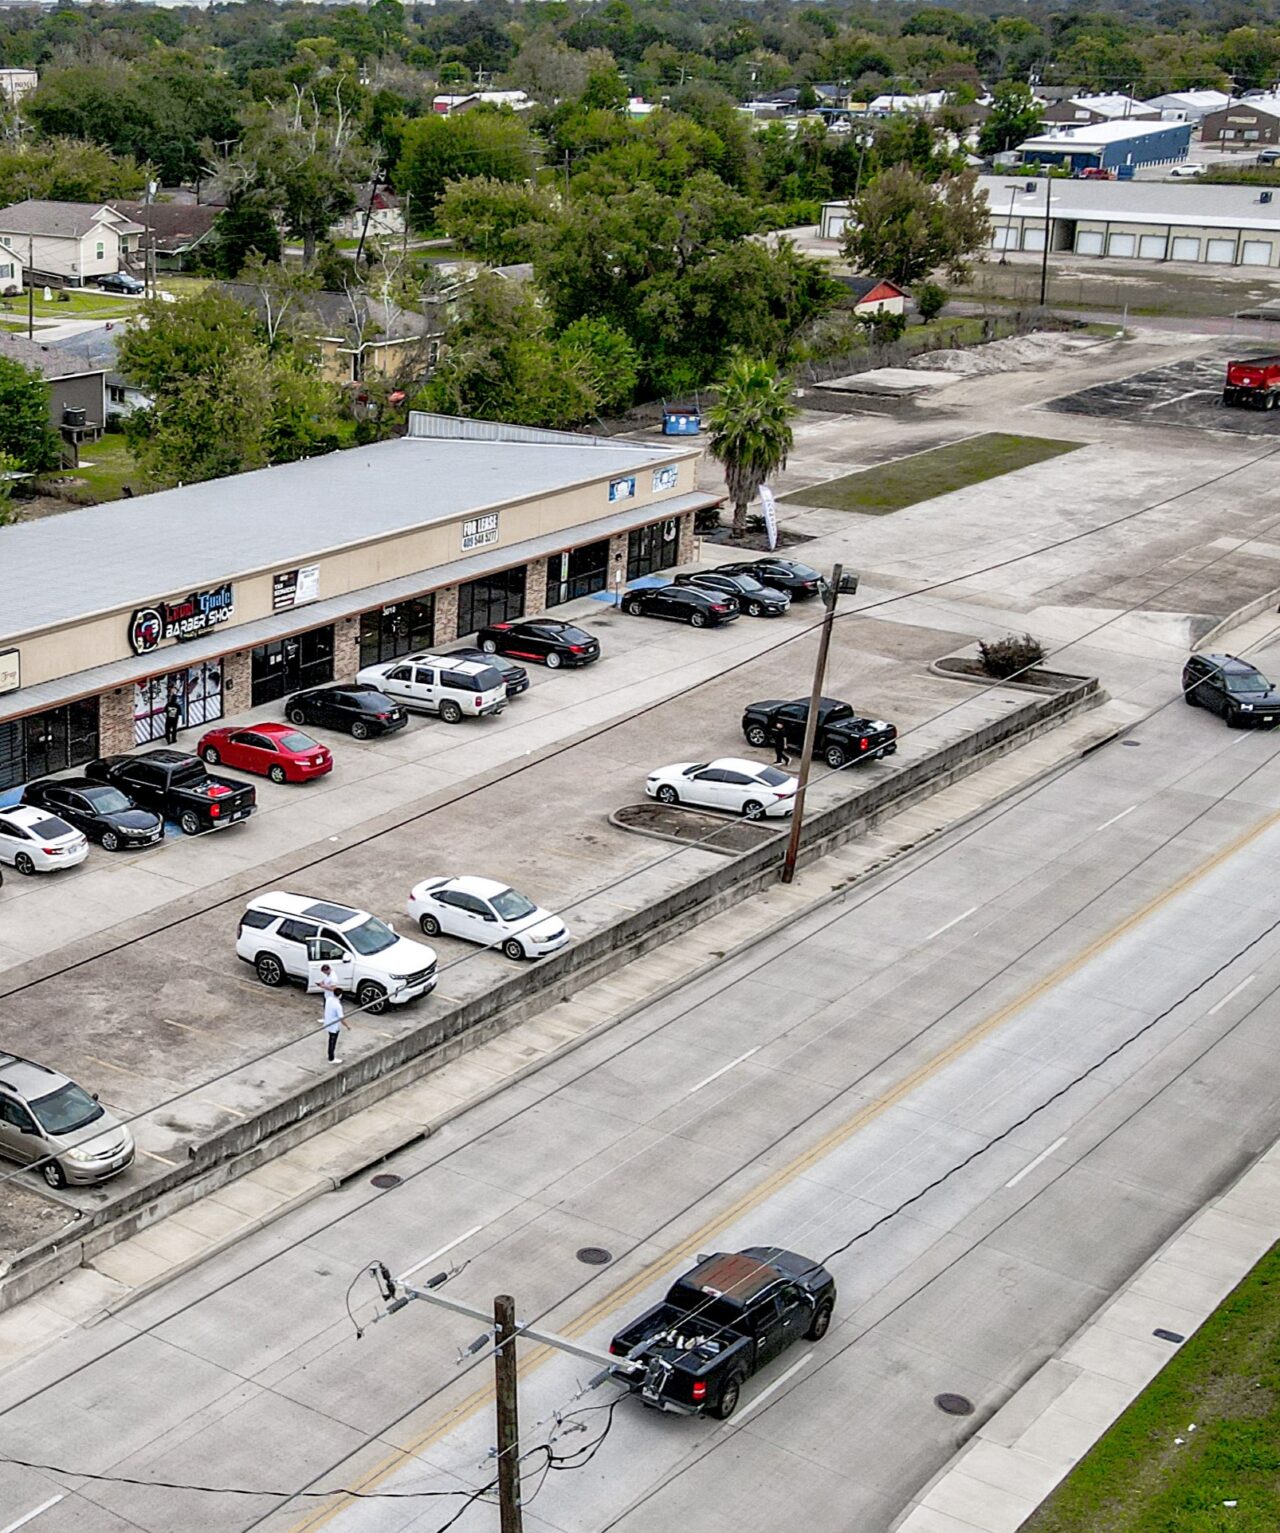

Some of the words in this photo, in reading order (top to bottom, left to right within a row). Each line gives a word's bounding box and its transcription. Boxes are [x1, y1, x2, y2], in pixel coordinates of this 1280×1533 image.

[463, 520, 477, 537] FOR
[478, 514, 497, 532] LEASE
[166, 614, 207, 638] BARBER
[208, 605, 235, 626] SHOP
